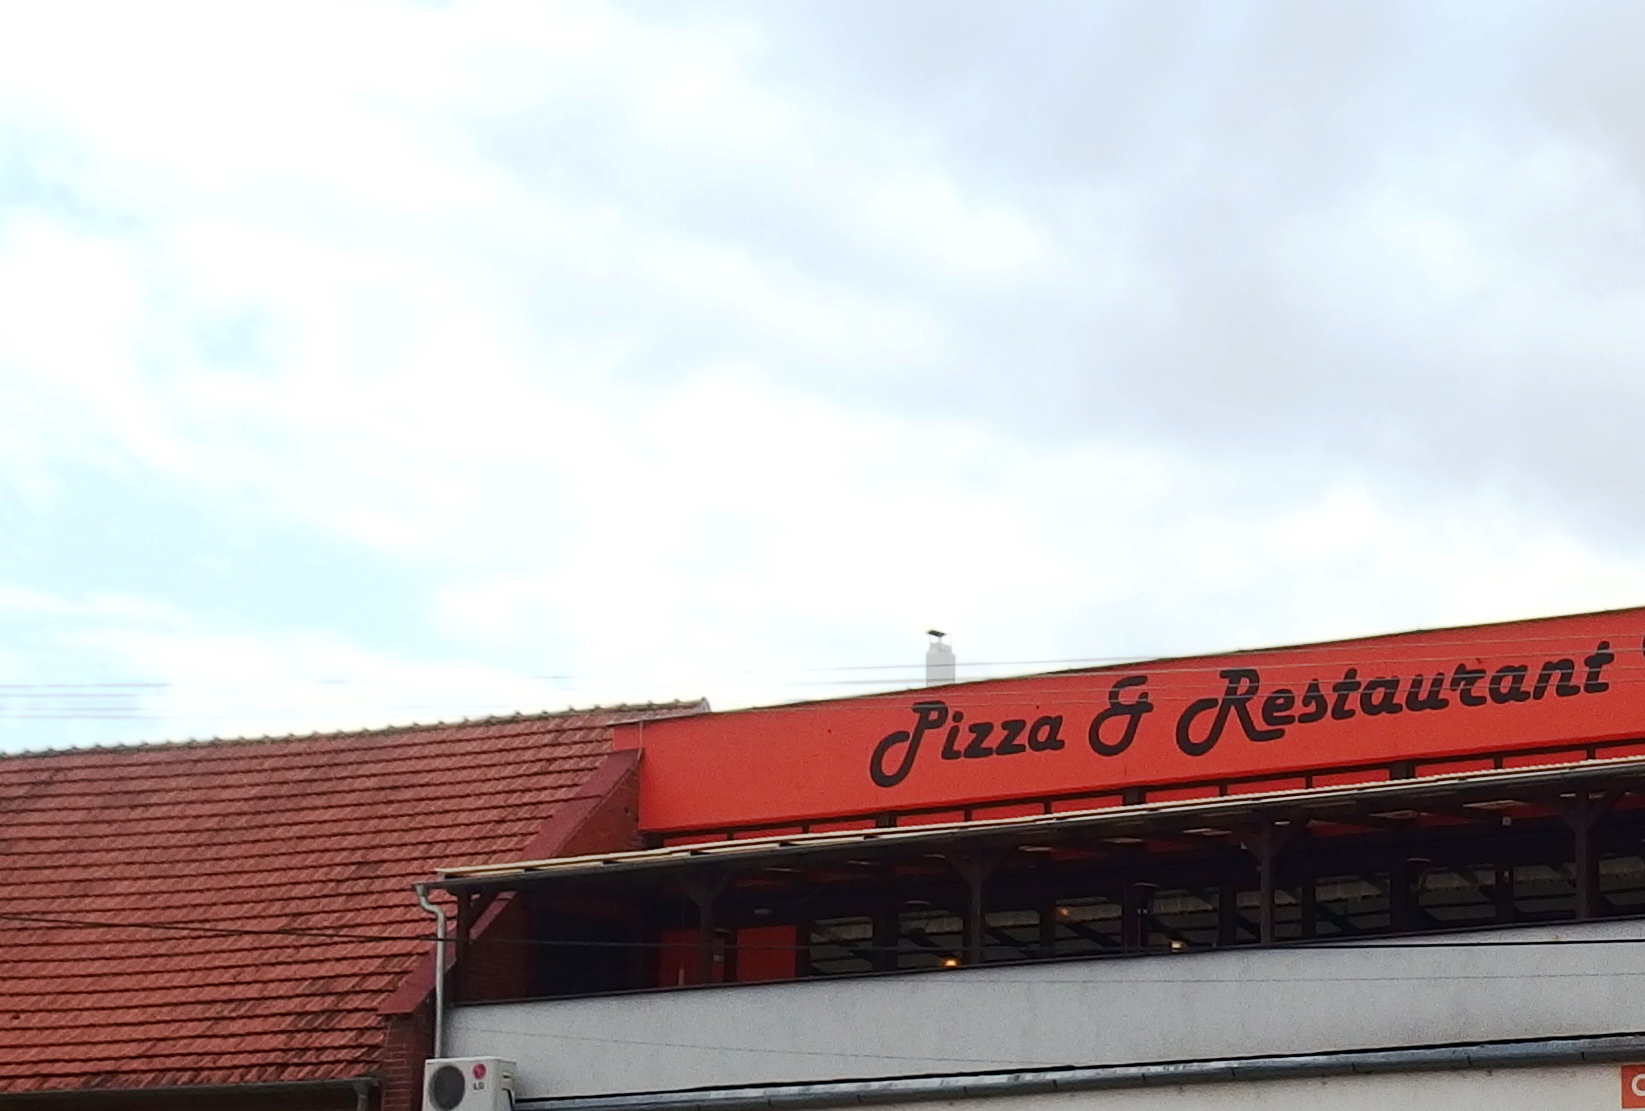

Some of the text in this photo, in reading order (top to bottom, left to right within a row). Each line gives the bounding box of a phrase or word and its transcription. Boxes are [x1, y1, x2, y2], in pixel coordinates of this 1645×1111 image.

[869, 701, 1066, 788] Pizza
[1088, 675, 1154, 757] &
[1175, 641, 1614, 757] Restaurant
[473, 1081, 485, 1091] LG
